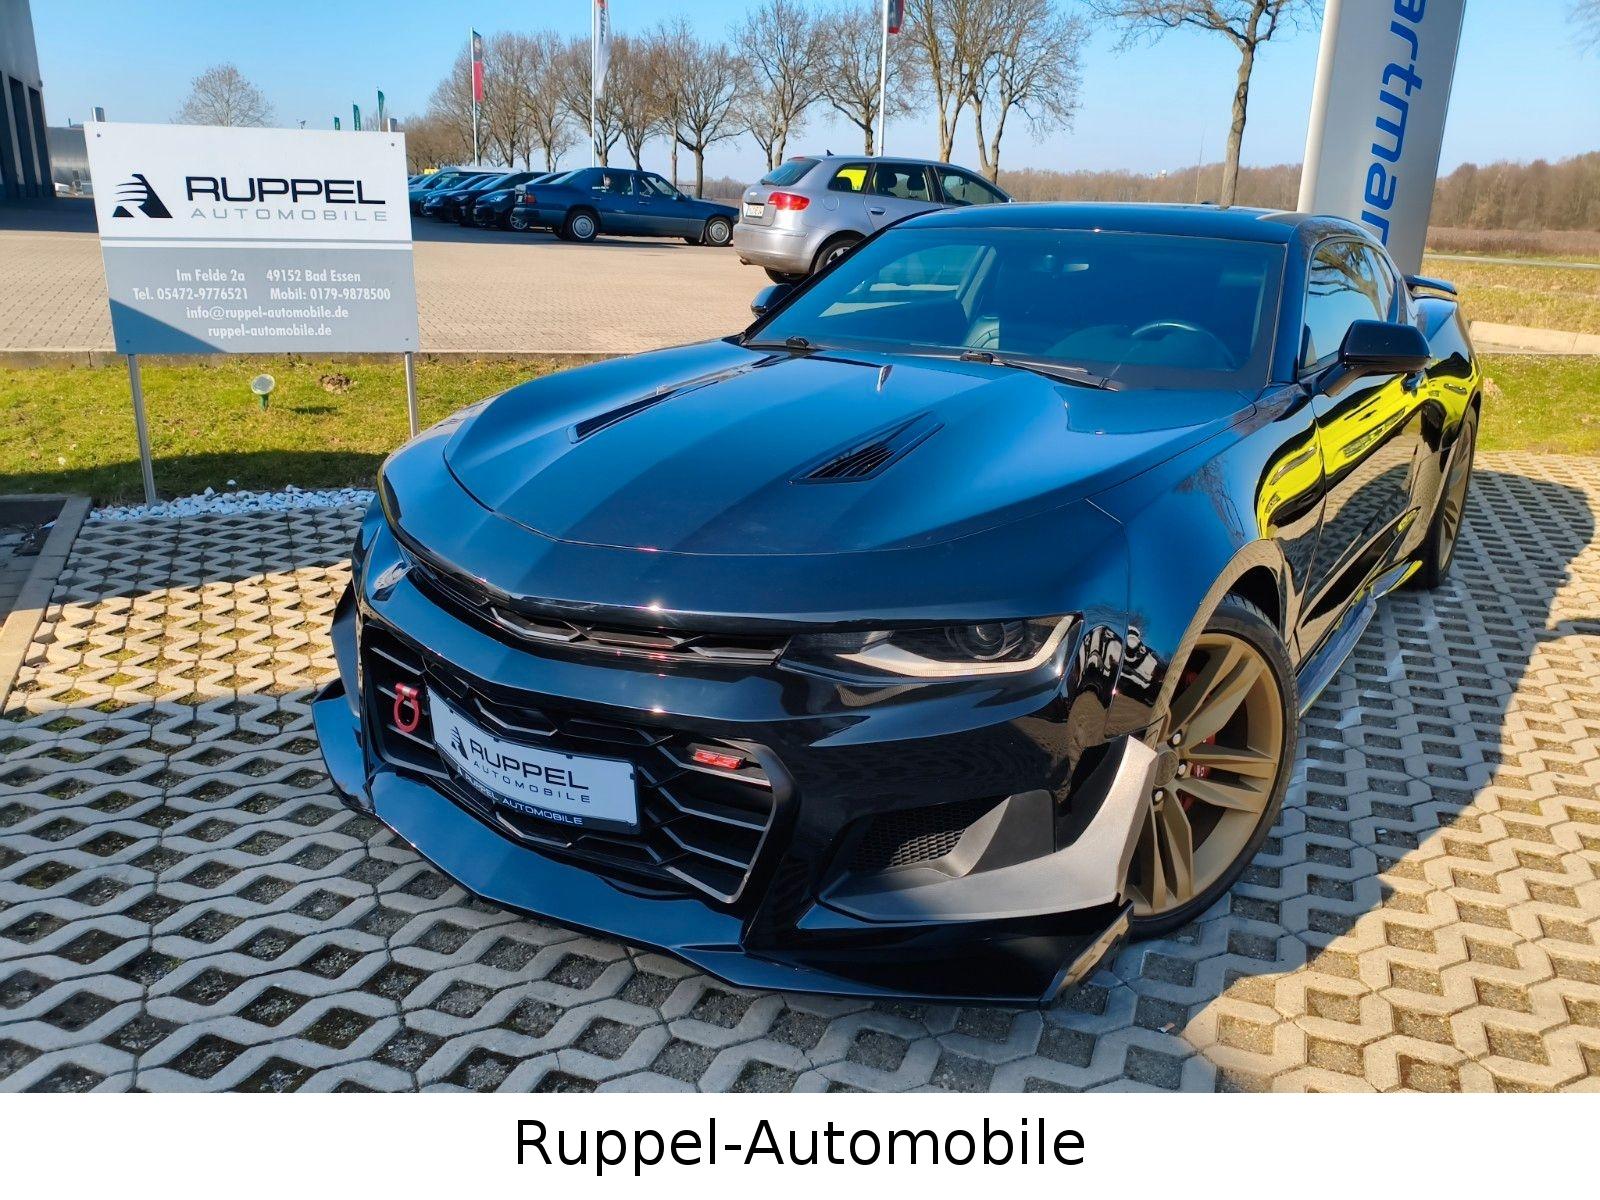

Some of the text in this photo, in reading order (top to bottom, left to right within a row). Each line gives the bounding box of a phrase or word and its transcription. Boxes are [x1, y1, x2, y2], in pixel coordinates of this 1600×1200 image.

[185, 176, 386, 205] RUPPEL
[190, 207, 387, 222] AUTOMOBILE
[176, 268, 246, 282] Im Felde 2a
[266, 269, 361, 283] 49152 Bad Essen
[132, 287, 248, 300] Tel. 05472-9776521
[270, 287, 391, 300] Mobil: 0179-9878500
[186, 305, 349, 321] info@ruppel-automobile.de
[208, 323, 332, 339] ruppel-automobile.de
[469, 738, 589, 790] RUPPEL
[473, 760, 591, 803] AUTOMOBILE
[502, 797, 584, 826] AUTOMOBILE
